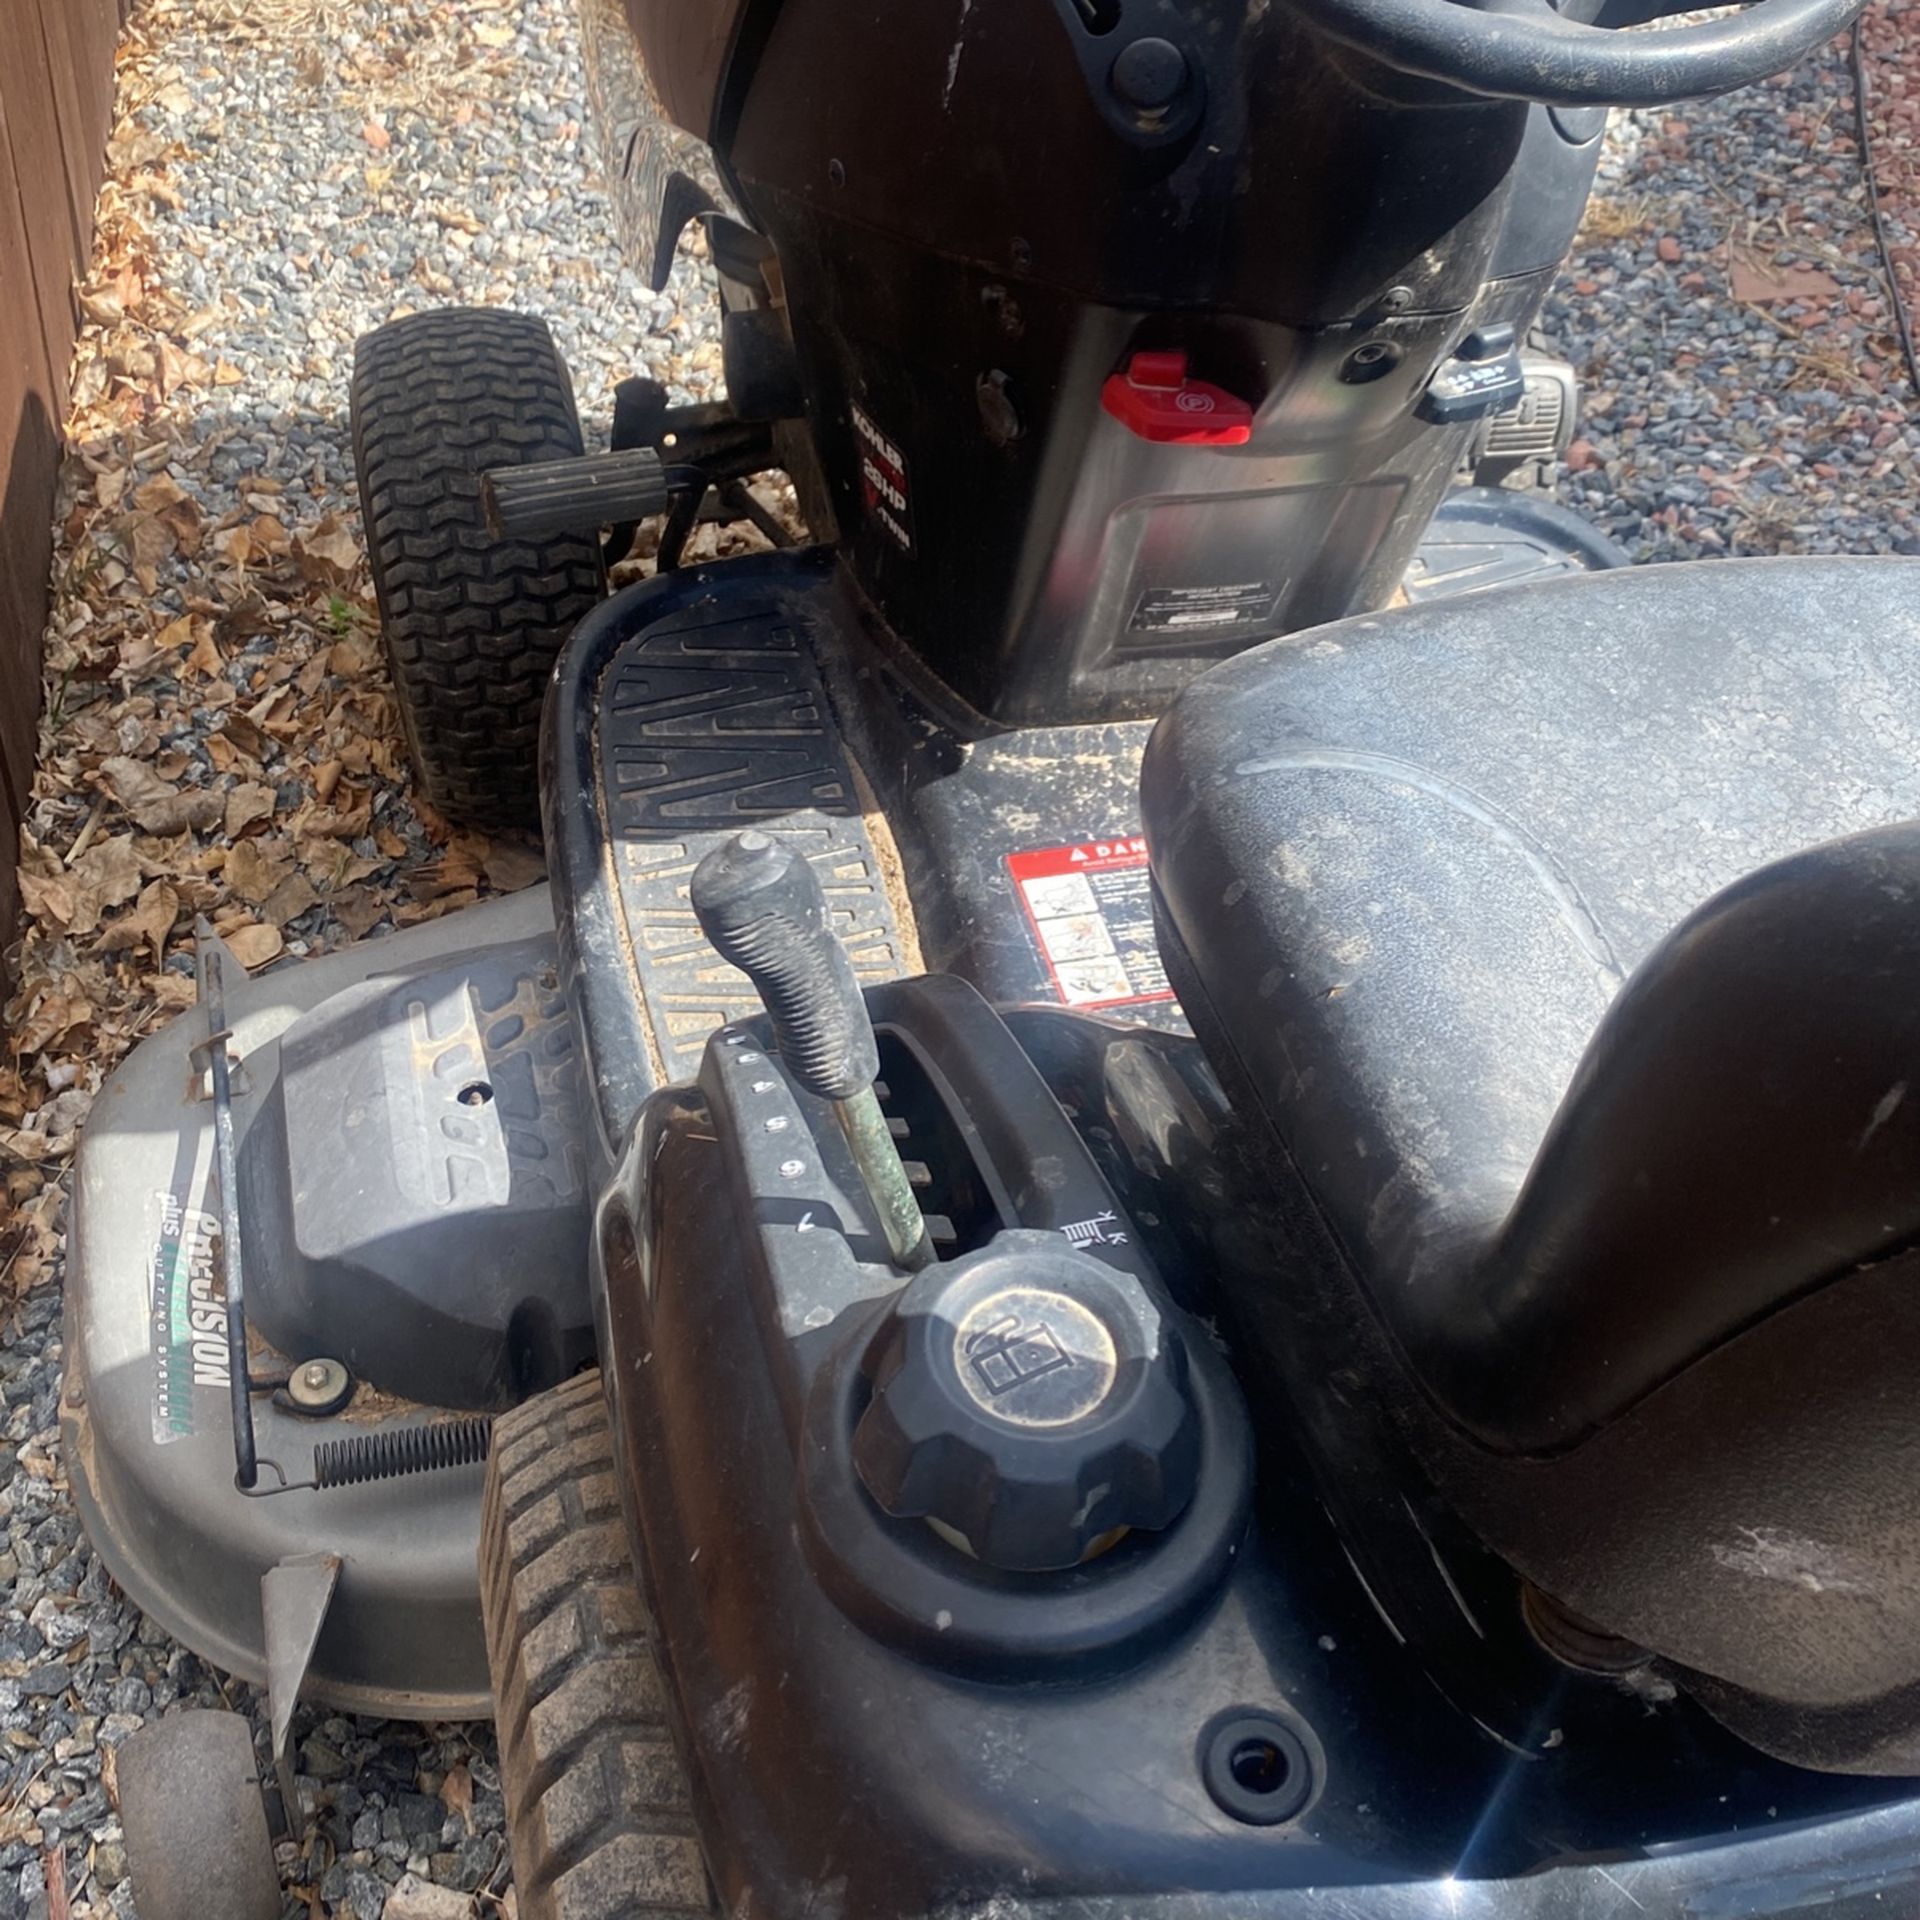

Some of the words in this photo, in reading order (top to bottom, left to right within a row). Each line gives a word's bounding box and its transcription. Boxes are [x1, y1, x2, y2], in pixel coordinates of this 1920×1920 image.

[852, 406, 905, 477] KOHLER
[1095, 838, 1148, 857] DAN
[156, 1191, 183, 1237] plus
[157, 1345, 169, 1418] SYSTEM
